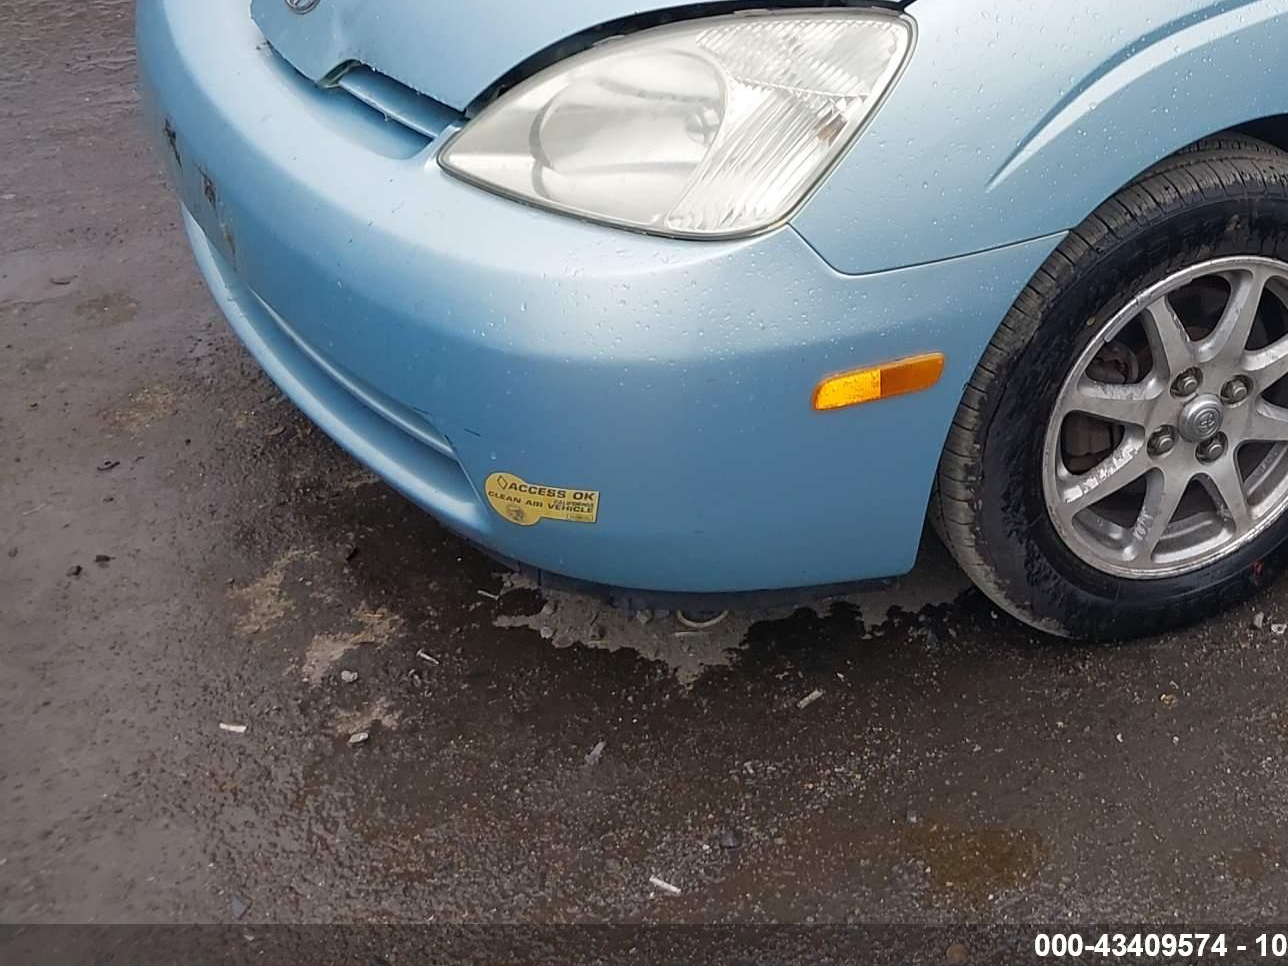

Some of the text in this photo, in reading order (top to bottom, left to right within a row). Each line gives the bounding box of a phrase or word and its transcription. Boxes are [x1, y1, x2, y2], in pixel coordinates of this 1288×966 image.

[508, 482, 595, 501] ACCESS OK
[488, 491, 593, 513] CLEAN AIR VEHICLE
